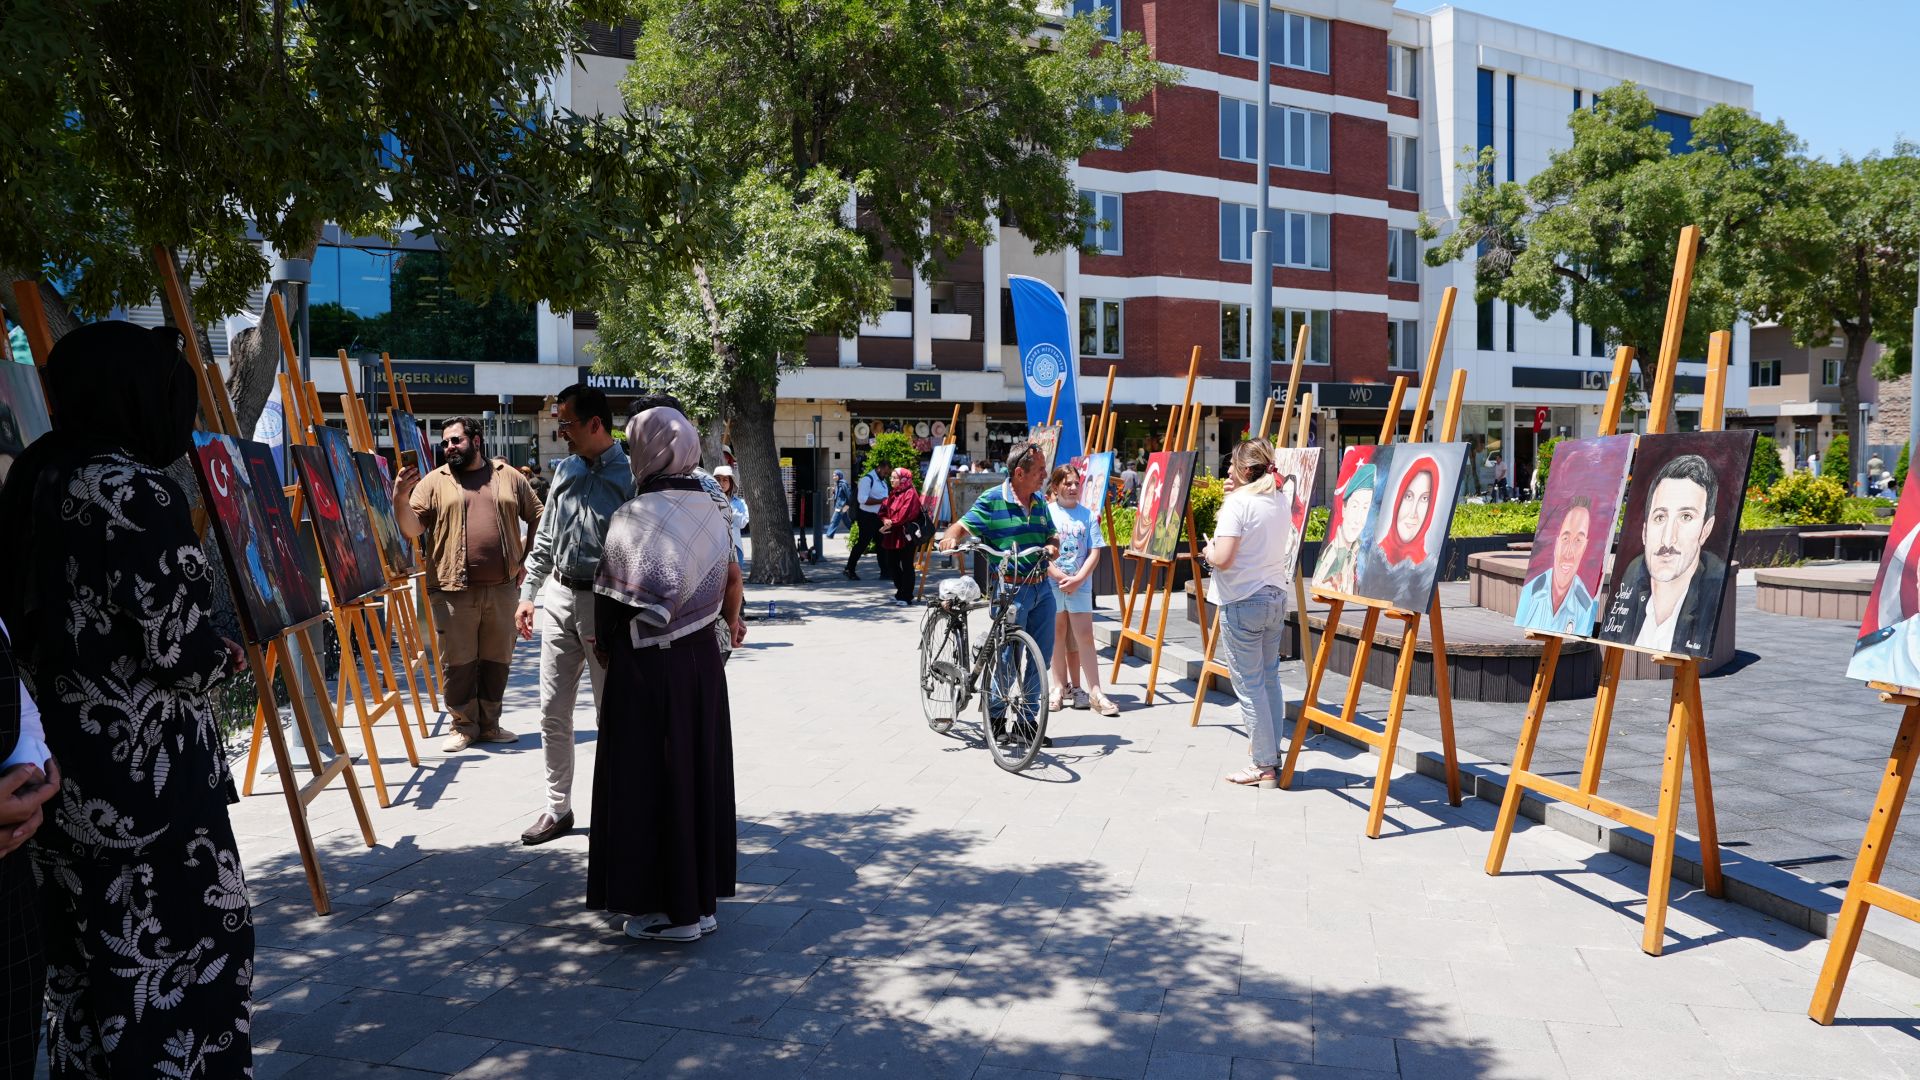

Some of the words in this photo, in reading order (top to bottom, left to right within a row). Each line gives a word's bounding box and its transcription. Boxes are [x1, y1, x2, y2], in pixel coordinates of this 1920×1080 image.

[374, 372, 430, 384] BURGER
[434, 374, 469, 385] KING
[1583, 371, 1602, 389] LC
[1349, 386, 1372, 402] MAD
